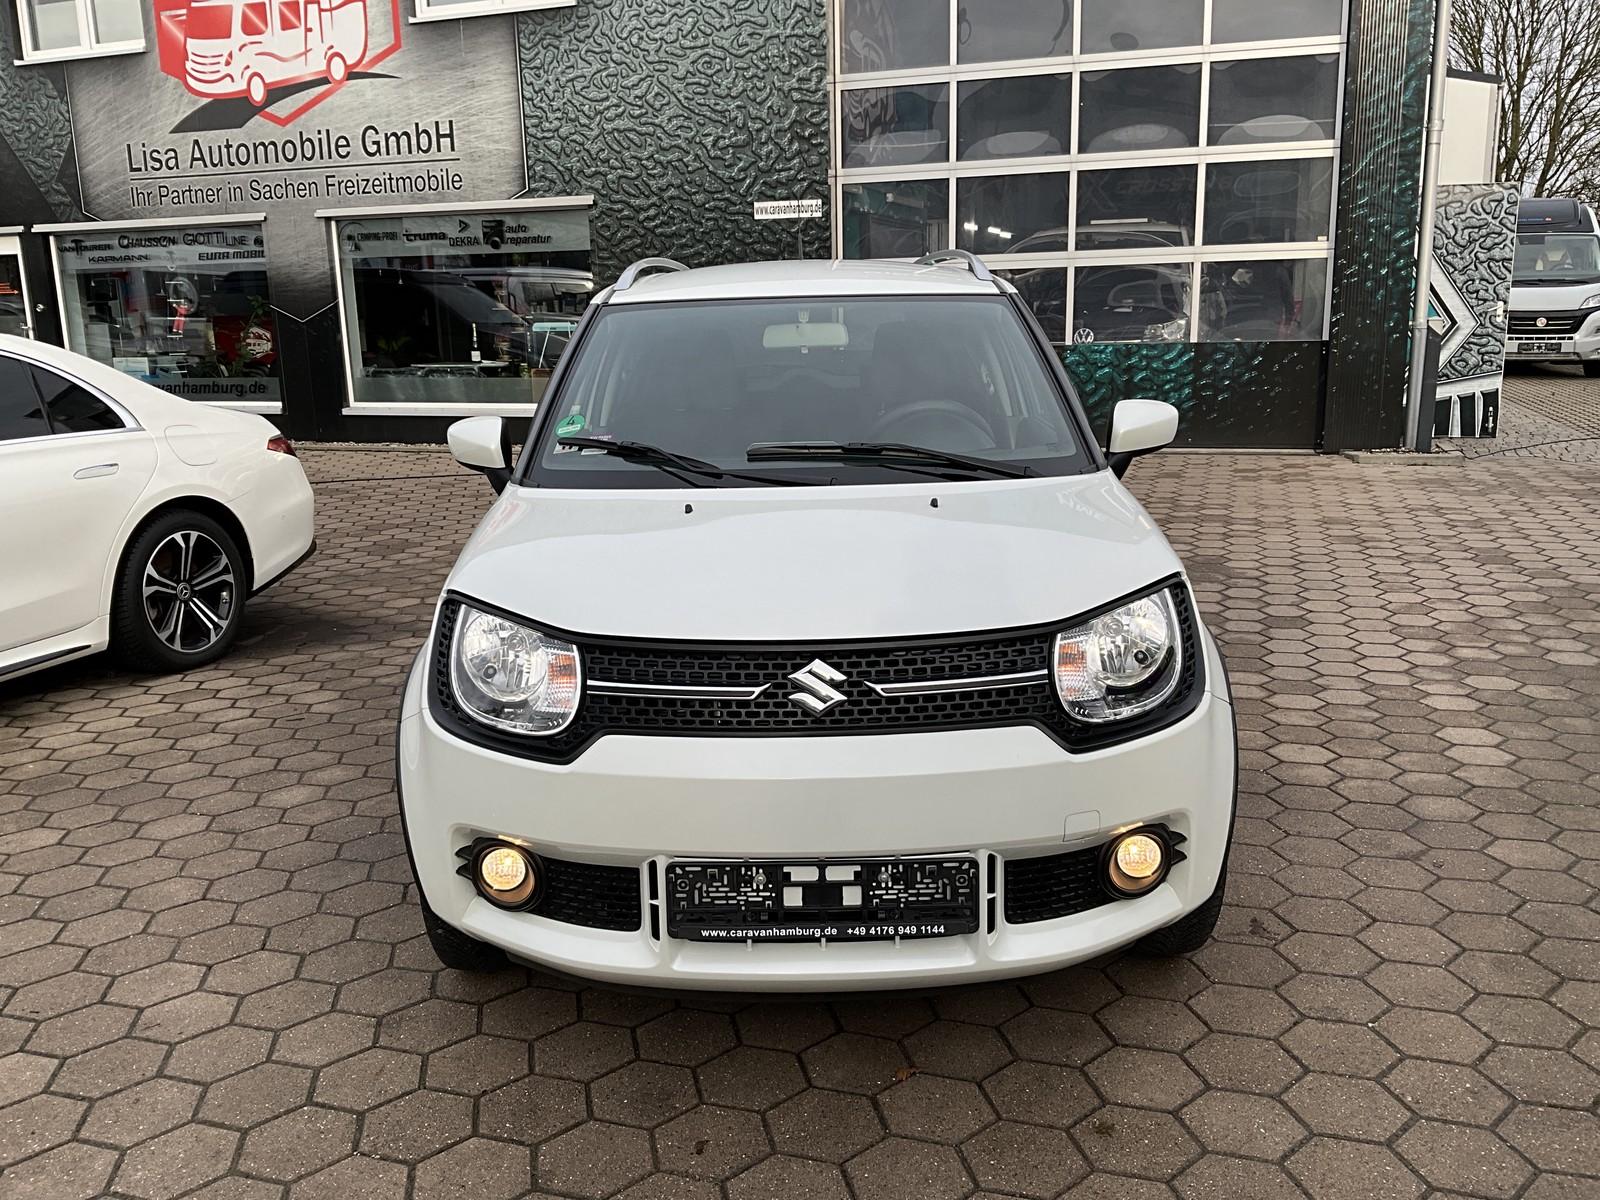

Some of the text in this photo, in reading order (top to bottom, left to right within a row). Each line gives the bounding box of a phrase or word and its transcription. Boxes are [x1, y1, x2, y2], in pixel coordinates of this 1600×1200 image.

[126, 120, 456, 172] Lisa Automobile GmbH
[130, 168, 463, 207] Ihr Partner in Sachen Freizeitmobile
[755, 202, 821, 217] www.caravanhamburg.de
[402, 228, 446, 242] truma
[505, 224, 528, 233] auto
[448, 236, 480, 247] DEKRA
[506, 234, 552, 246] reparatur
[153, 381, 266, 396] vanhamburg.de
[701, 925, 945, 938] www.caravanhamburg.de +49 4176 949 1144
